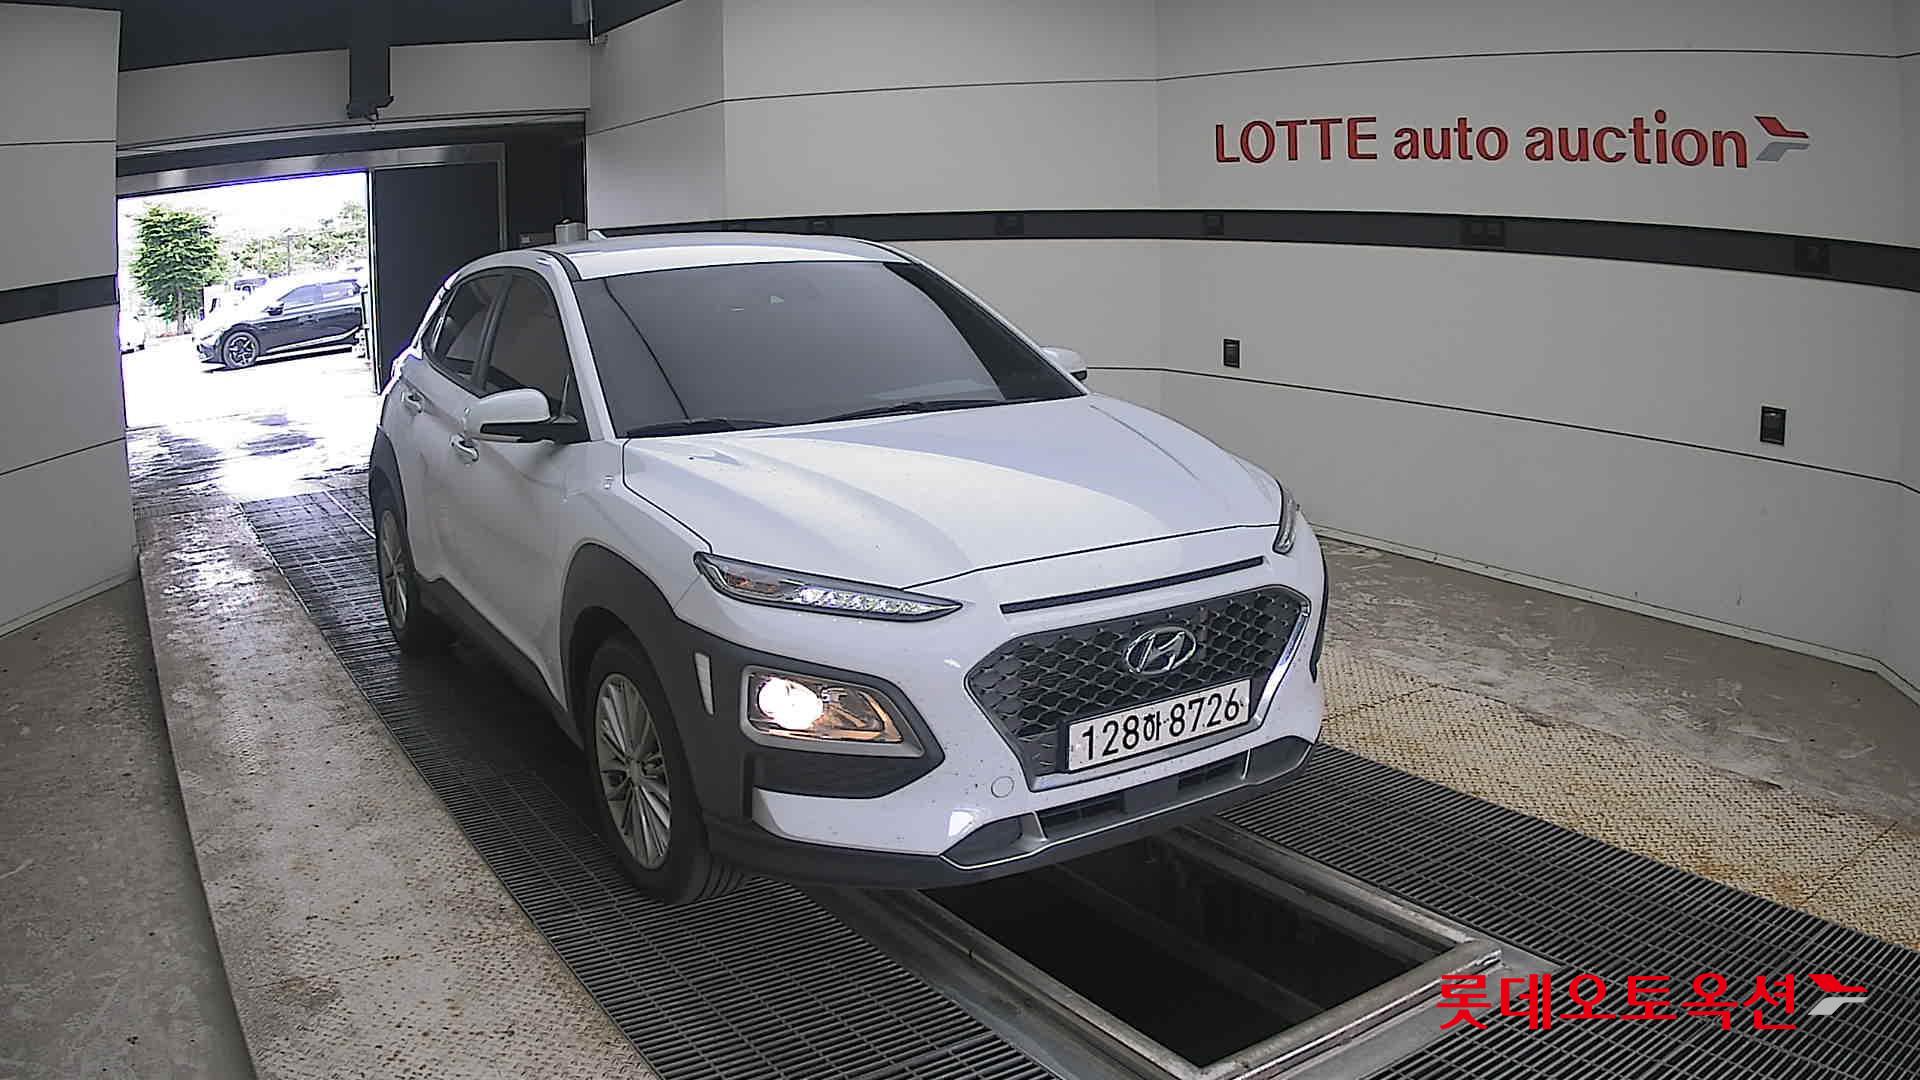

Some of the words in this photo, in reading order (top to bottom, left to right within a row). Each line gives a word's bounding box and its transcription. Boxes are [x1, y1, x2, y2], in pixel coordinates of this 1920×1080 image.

[1215, 116, 1378, 163] LOTTE
[1392, 116, 1508, 162] auto
[1524, 109, 1748, 168] auction
